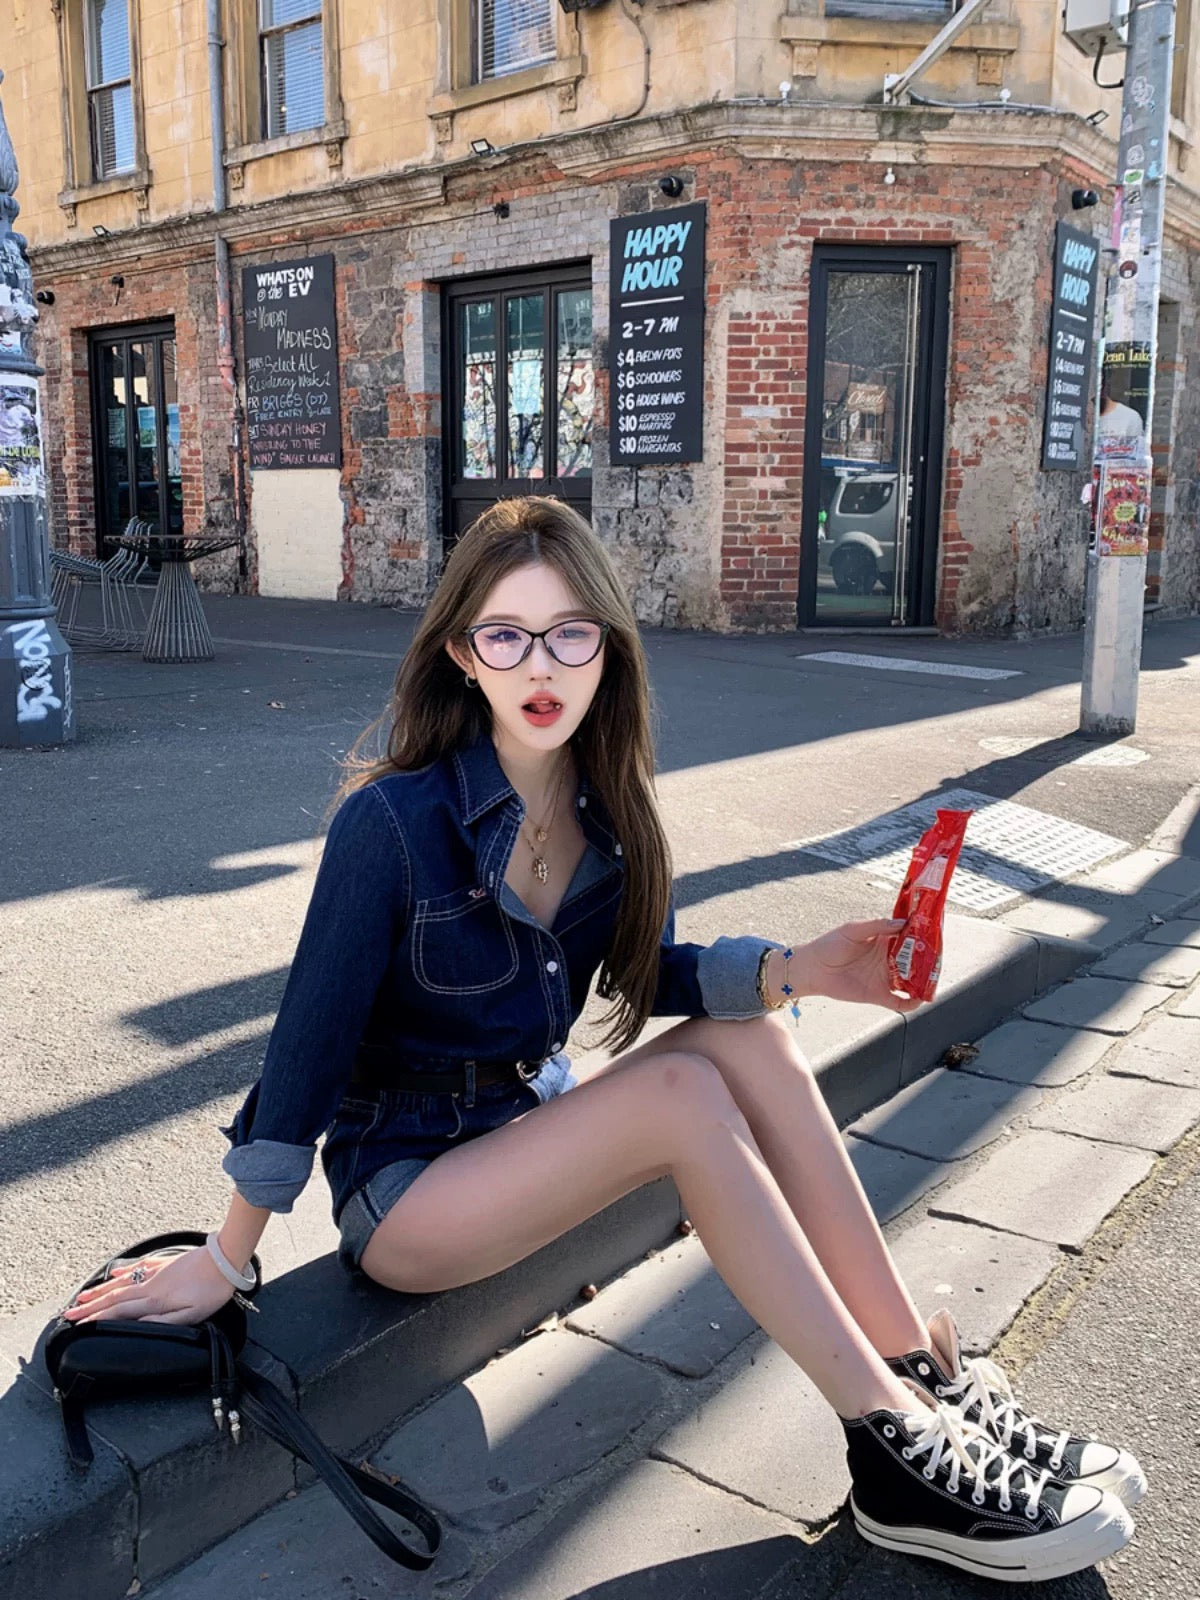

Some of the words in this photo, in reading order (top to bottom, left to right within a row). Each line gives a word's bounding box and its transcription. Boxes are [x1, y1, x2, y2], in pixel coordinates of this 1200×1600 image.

[624, 221, 692, 258] HAPPY
[1063, 238, 1096, 274] HAPPY
[621, 255, 683, 292] HOUR
[257, 288, 266, 302] @
[268, 284, 283, 300] the
[289, 280, 311, 297] EV
[1060, 272, 1090, 306] HOUR
[276, 326, 332, 350] MADNESS
[622, 318, 655, 339] 2-7
[658, 316, 679, 333] PM
[1056, 330, 1075, 352] 2-7
[616, 348, 635, 368] $4
[662, 347, 683, 361] POTS
[616, 369, 635, 389] $6
[635, 369, 683, 385] SCHOONERS
[247, 394, 260, 411] FRI
[261, 391, 304, 411] BRIGGS
[617, 391, 635, 412] $6
[635, 392, 661, 407] HOUSE
[660, 391, 686, 406] WINES
[278, 408, 304, 418] ENTRY
[618, 413, 638, 434] $10
[639, 411, 677, 423] ESPRESSO
[295, 422, 327, 436] HONEY
[619, 436, 638, 455] $10
[639, 434, 669, 445] FROZEN
[637, 442, 683, 455] MARGARITAS
